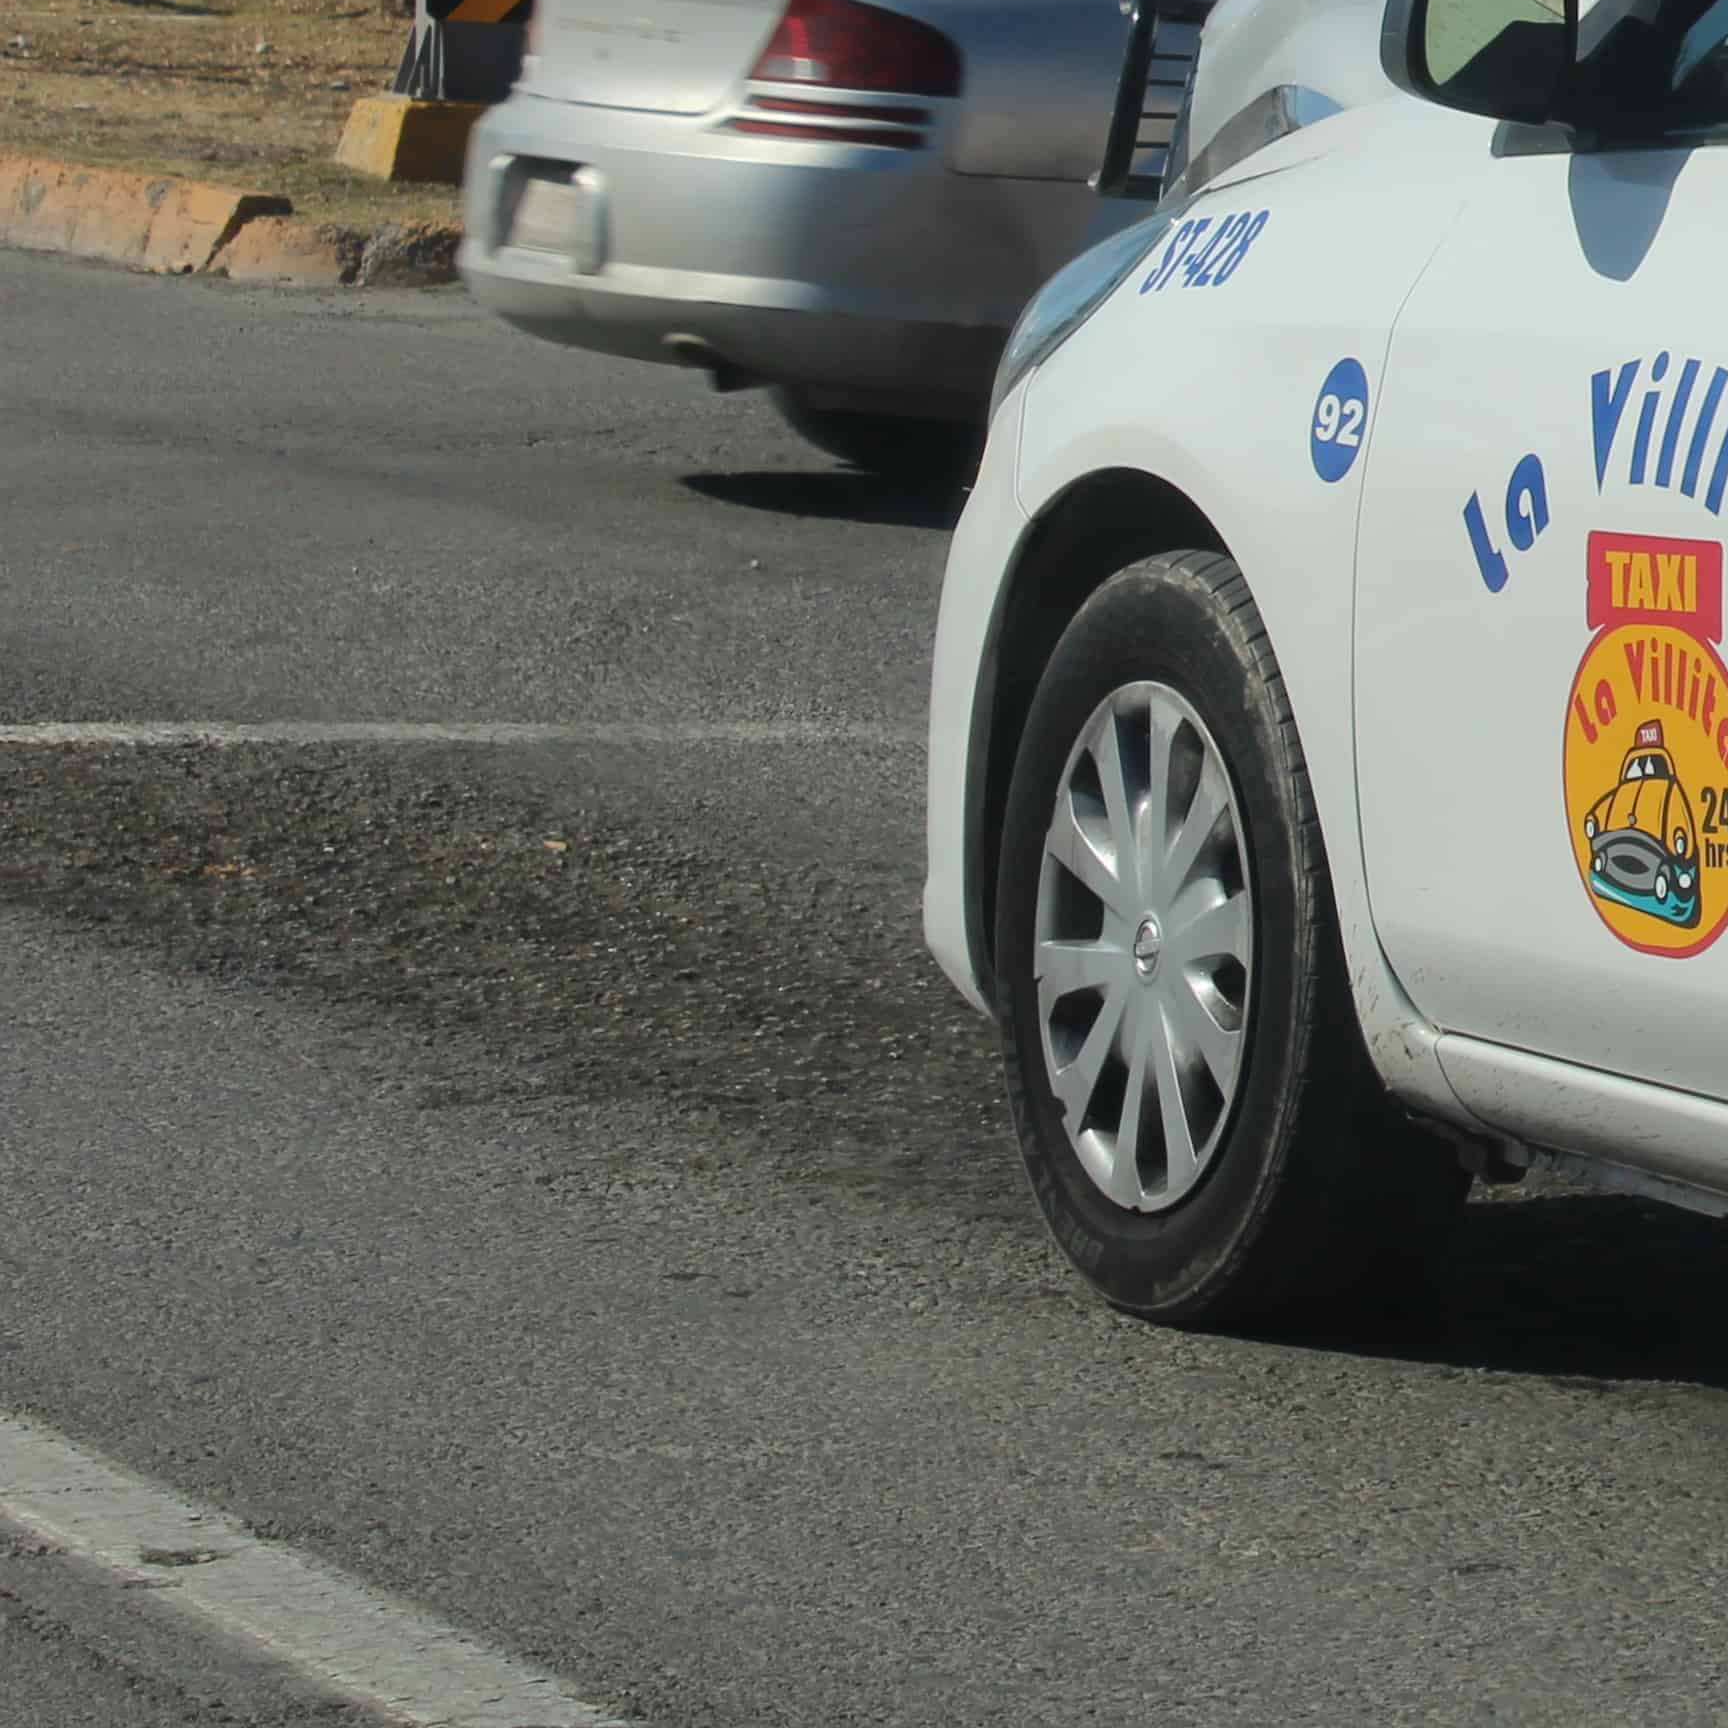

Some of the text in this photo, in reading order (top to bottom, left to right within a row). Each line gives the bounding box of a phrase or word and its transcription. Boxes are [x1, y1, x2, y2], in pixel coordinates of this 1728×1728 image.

[1139, 209, 1270, 295] ST-428
[1315, 393, 1364, 448] 92
[1605, 550, 1697, 614] TAXI
